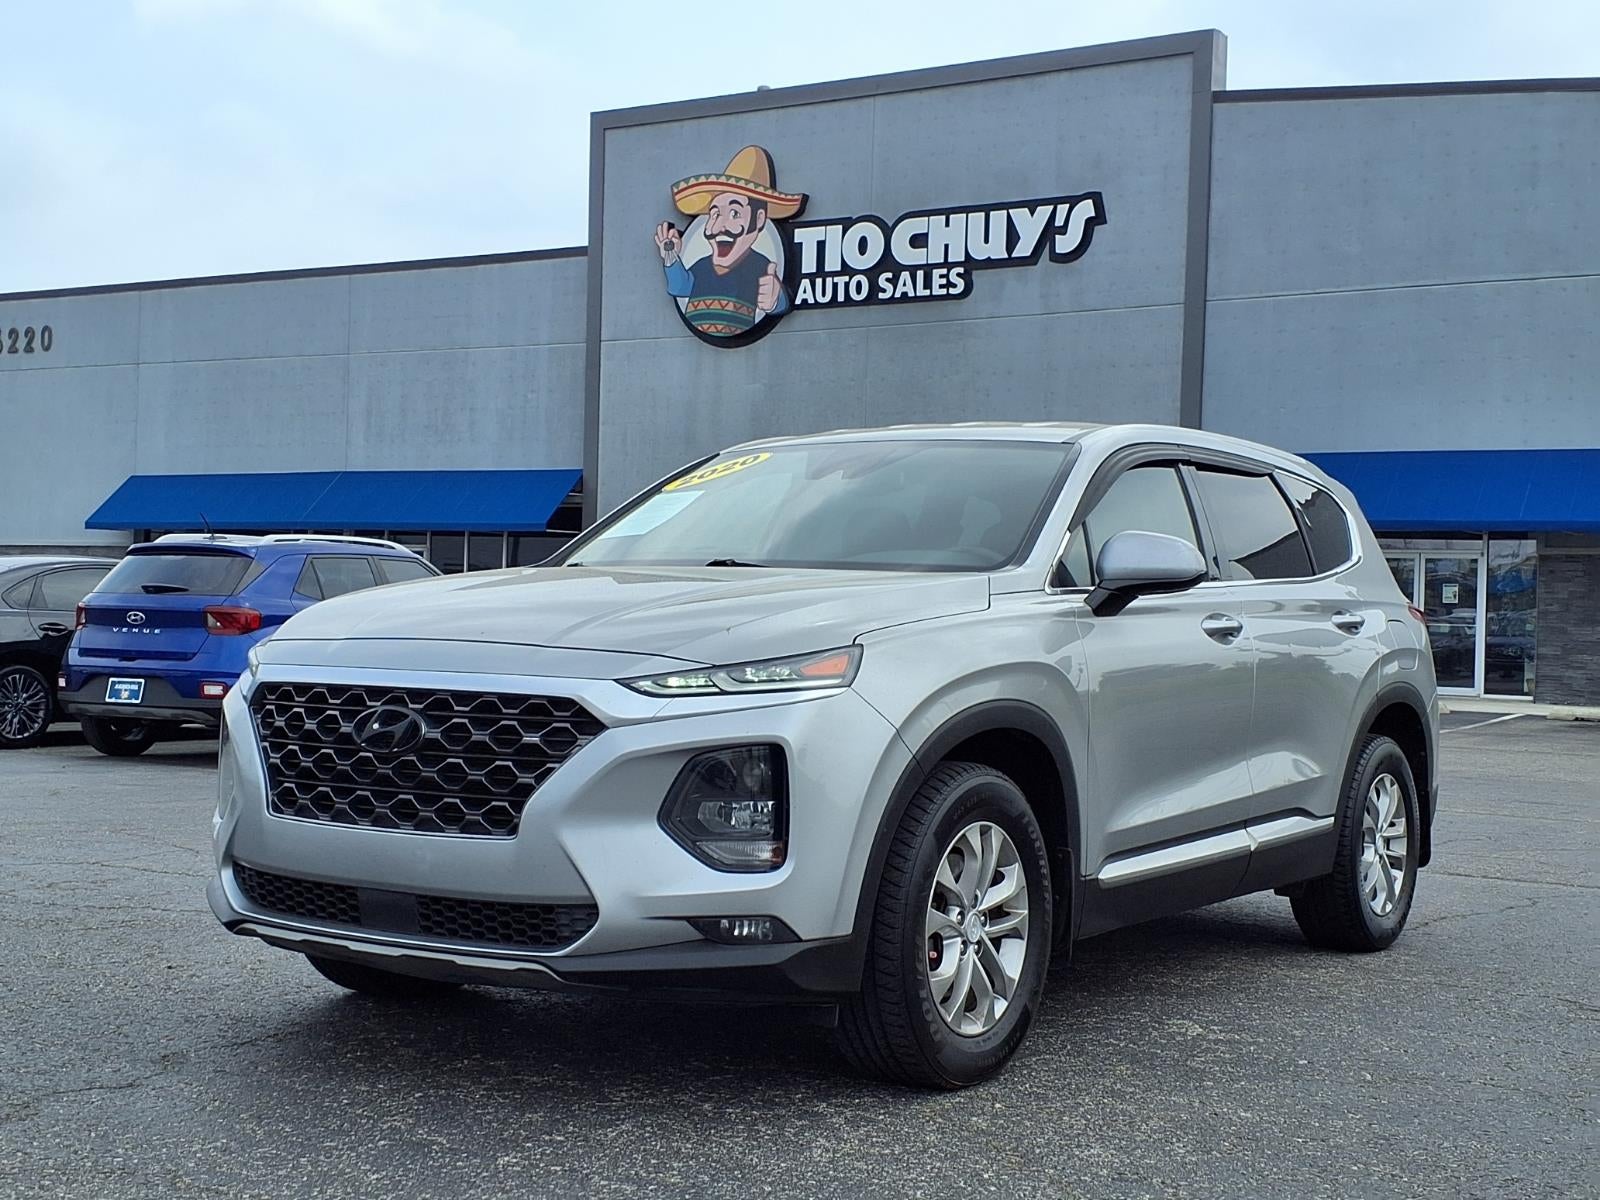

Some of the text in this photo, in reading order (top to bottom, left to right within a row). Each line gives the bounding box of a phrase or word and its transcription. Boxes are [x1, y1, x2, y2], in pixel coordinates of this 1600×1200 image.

[794, 198, 1095, 273] TIO CHUY'S
[794, 267, 965, 305] AUTO SALES
[0, 325, 53, 354] 220
[674, 455, 761, 488] 2020
